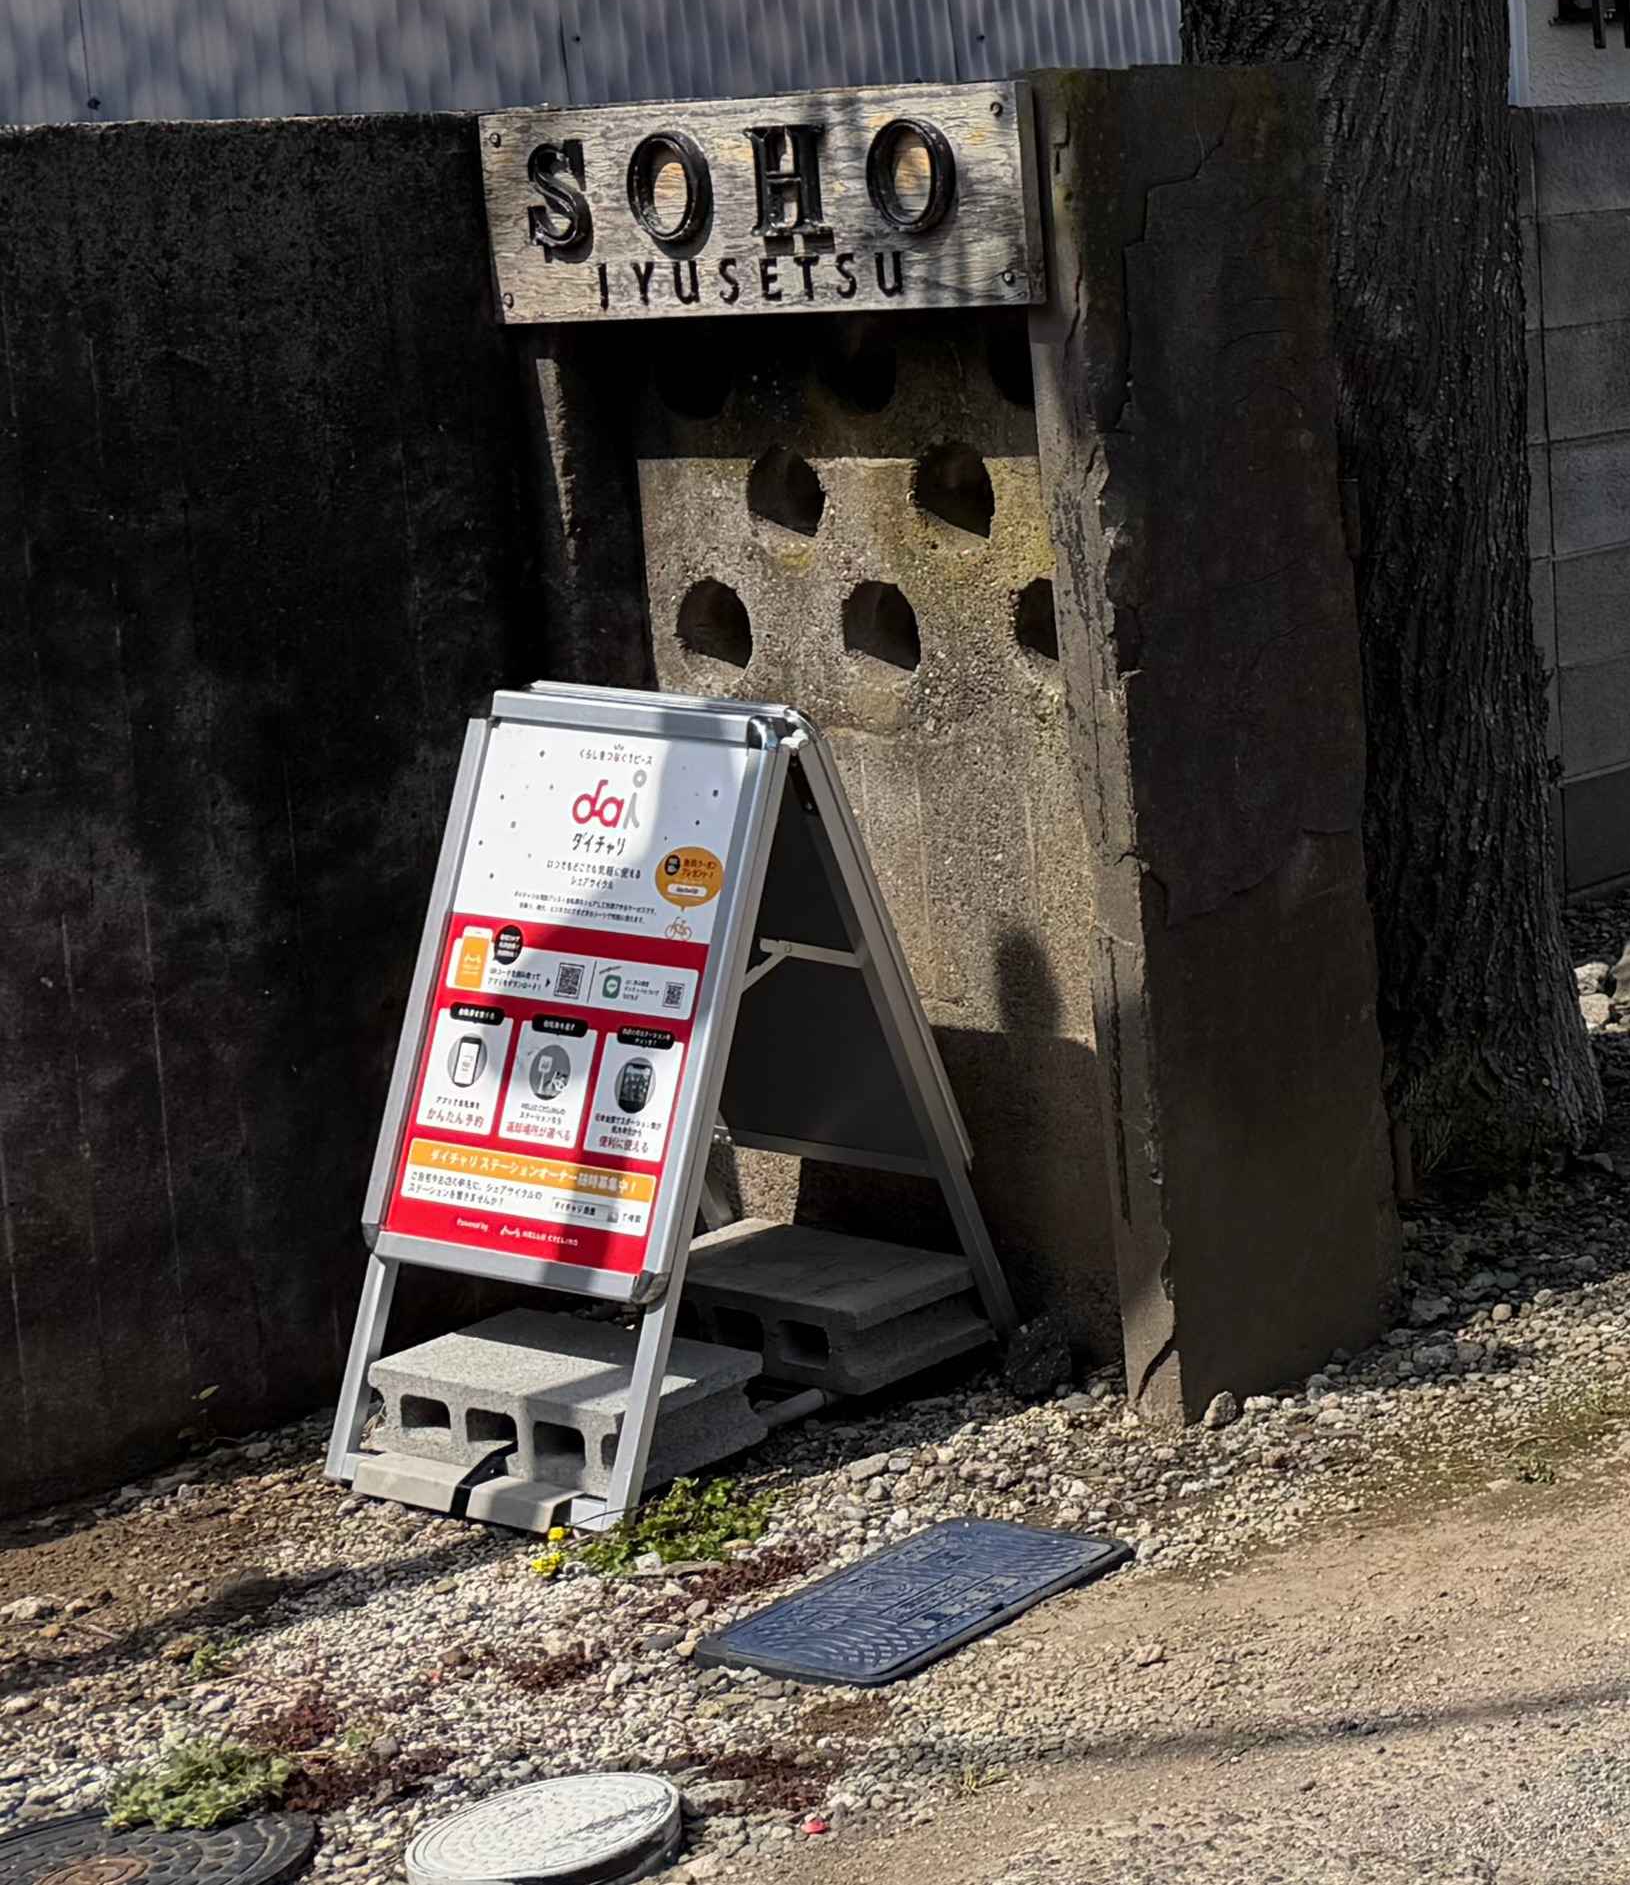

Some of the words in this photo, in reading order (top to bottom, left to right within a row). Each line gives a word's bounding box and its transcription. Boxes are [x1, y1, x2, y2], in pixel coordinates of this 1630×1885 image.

[527, 117, 957, 252] SOHO
[572, 770, 648, 830] dai
[572, 832, 627, 856] ダイチャリ
